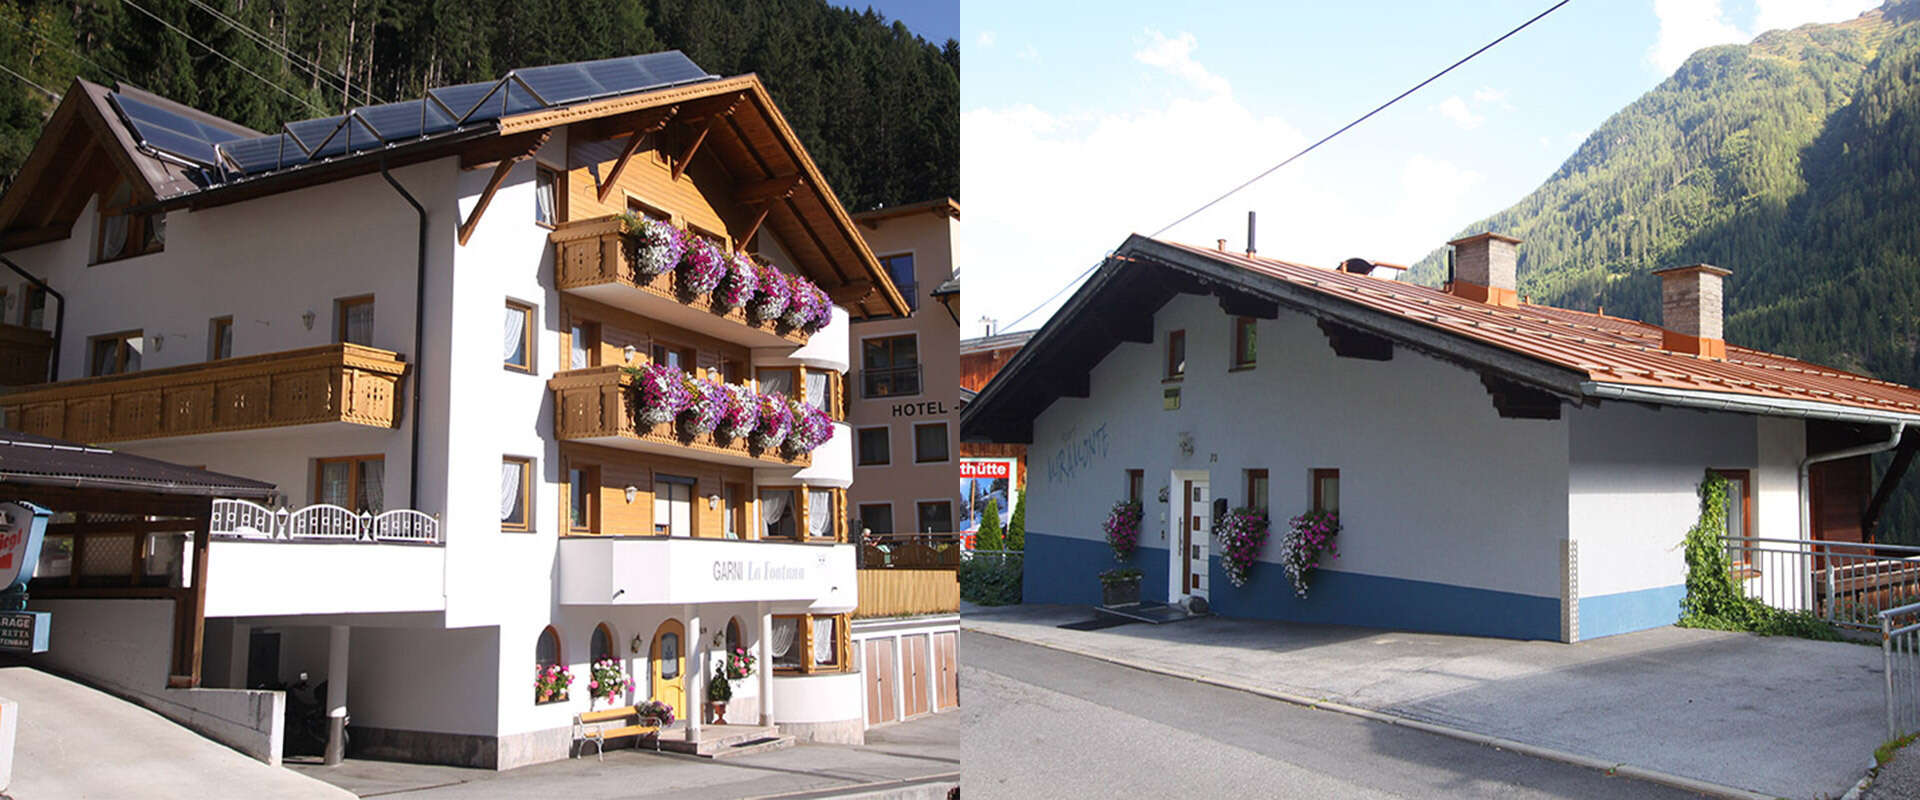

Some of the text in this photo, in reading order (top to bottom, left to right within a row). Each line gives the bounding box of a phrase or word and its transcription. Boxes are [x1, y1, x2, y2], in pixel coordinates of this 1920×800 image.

[892, 402, 948, 417] HOTEL
[960, 463, 1007, 475] thütte
[713, 560, 805, 581] GARNI La Fontana
